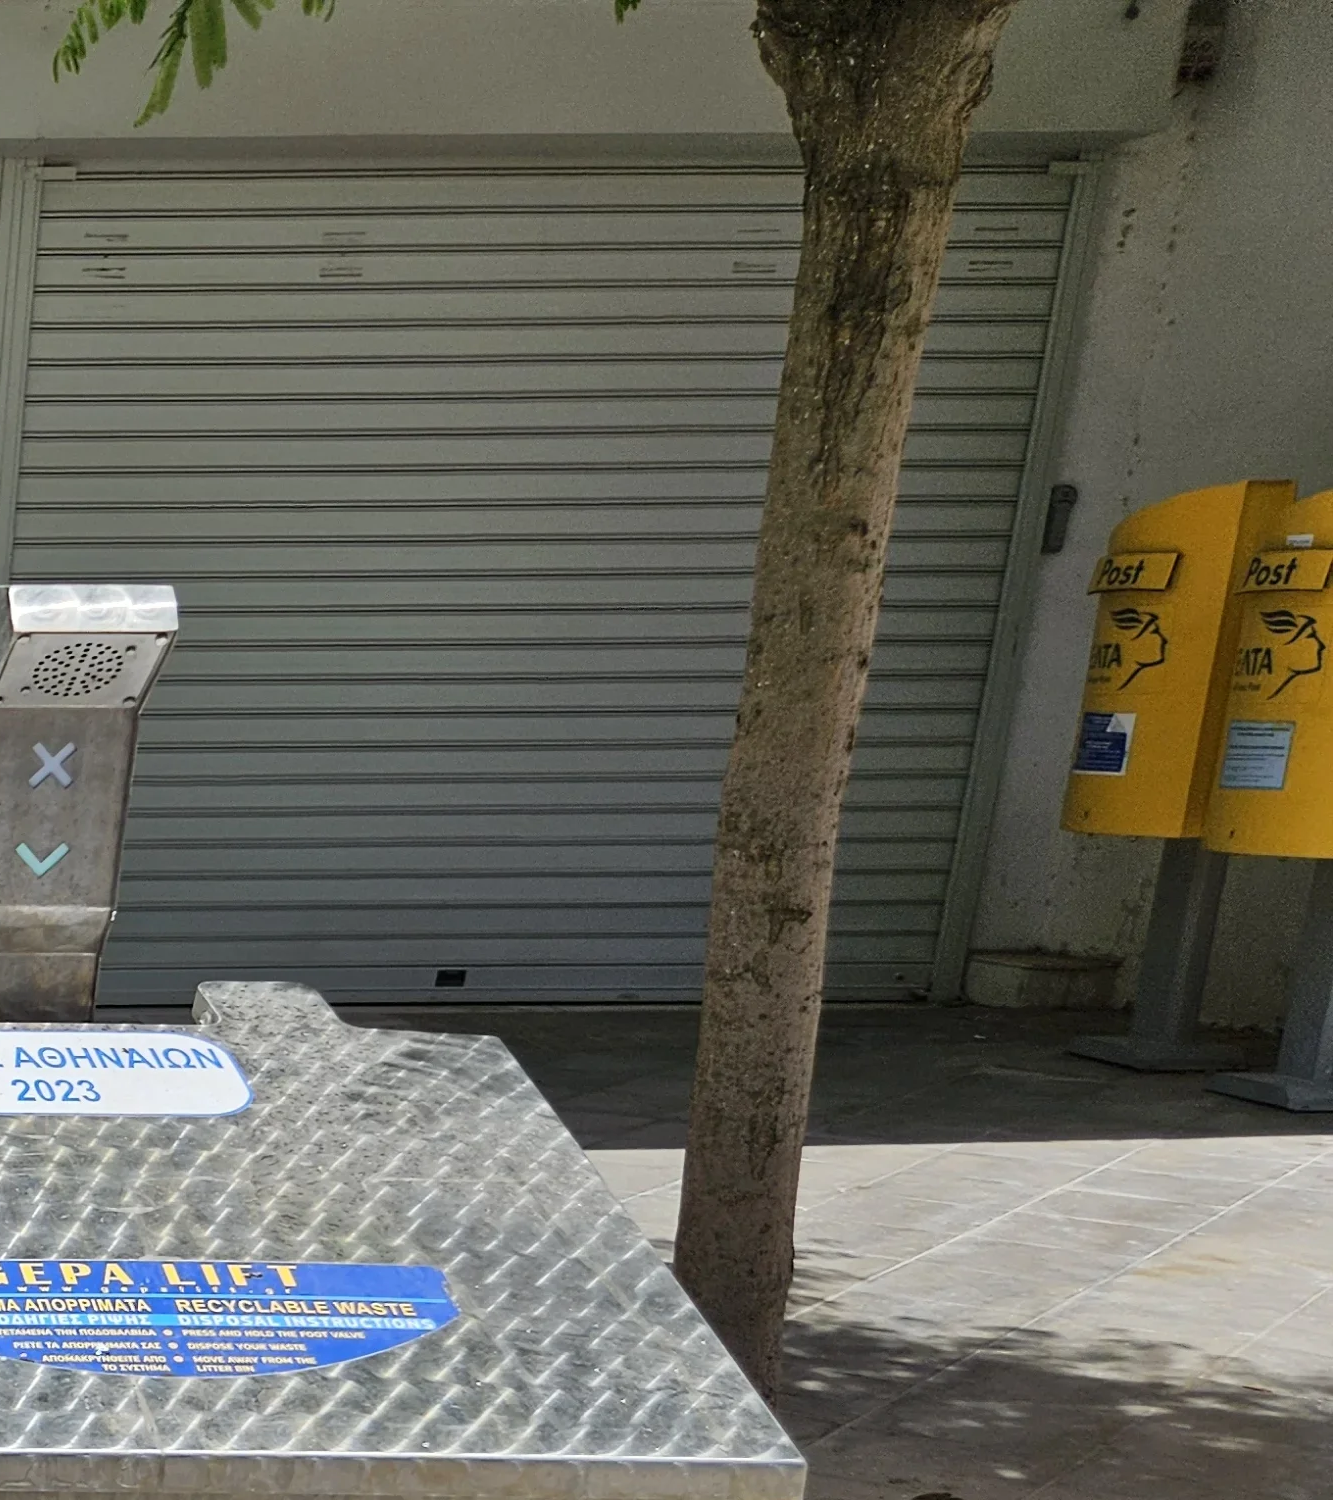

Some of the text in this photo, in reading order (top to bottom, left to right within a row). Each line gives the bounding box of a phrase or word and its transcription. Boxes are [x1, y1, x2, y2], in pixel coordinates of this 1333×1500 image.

[1097, 559, 1145, 586] Post
[1242, 556, 1297, 588] Post
[14, 1046, 225, 1069] ΑΘΗΝΑΙΩΝ
[10, 1079, 102, 1103] 2023
[161, 1263, 297, 1288] LIFT
[24, 1298, 152, 1313] ΑΠΟΡΡΙΜΑΤΑ
[175, 1298, 418, 1317] RECYCLABLE WASTE
[88, 1314, 153, 1326] ΡΙΨΗΣ
[177, 1315, 437, 1330] DISPOSAL INSTRUCTIONS
